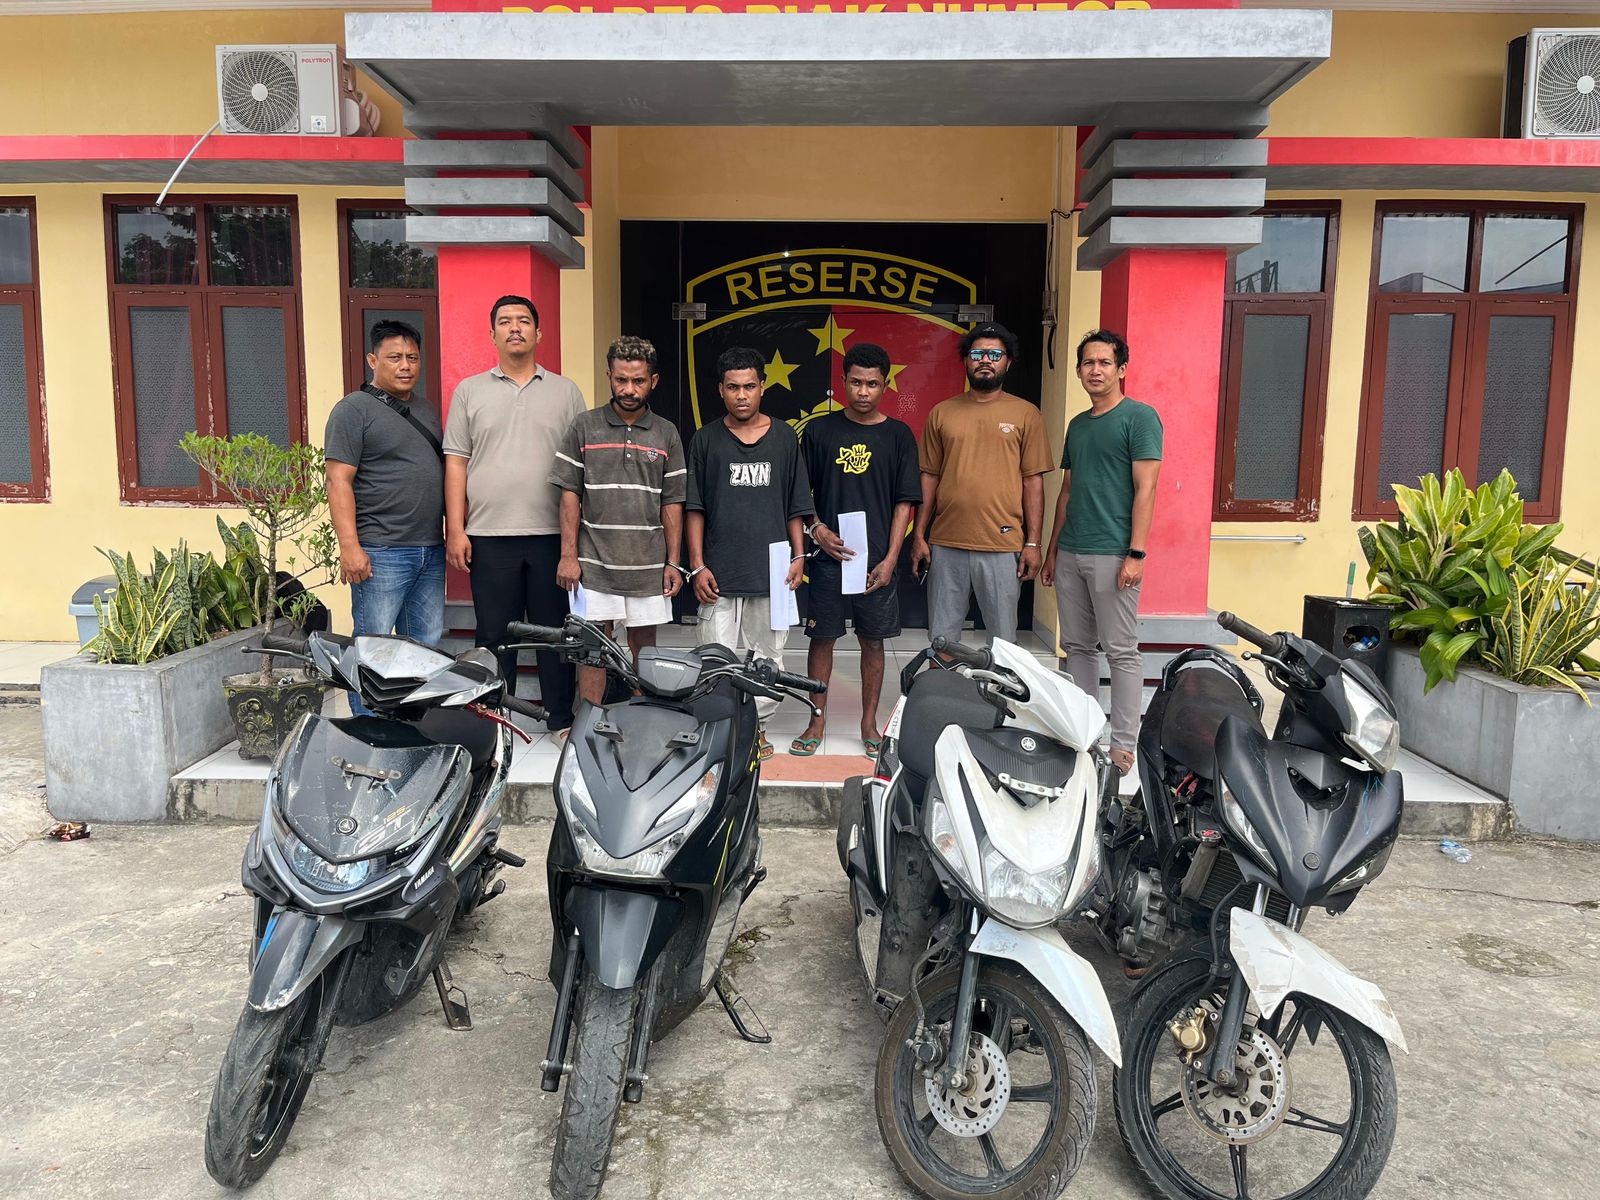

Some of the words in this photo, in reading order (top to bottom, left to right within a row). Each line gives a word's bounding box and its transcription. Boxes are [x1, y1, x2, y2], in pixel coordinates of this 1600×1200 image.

[725, 261, 939, 307] RESERSE
[730, 462, 771, 487] ZAYN
[655, 661, 684, 670] HONDA
[414, 867, 435, 889] YAMAHA
